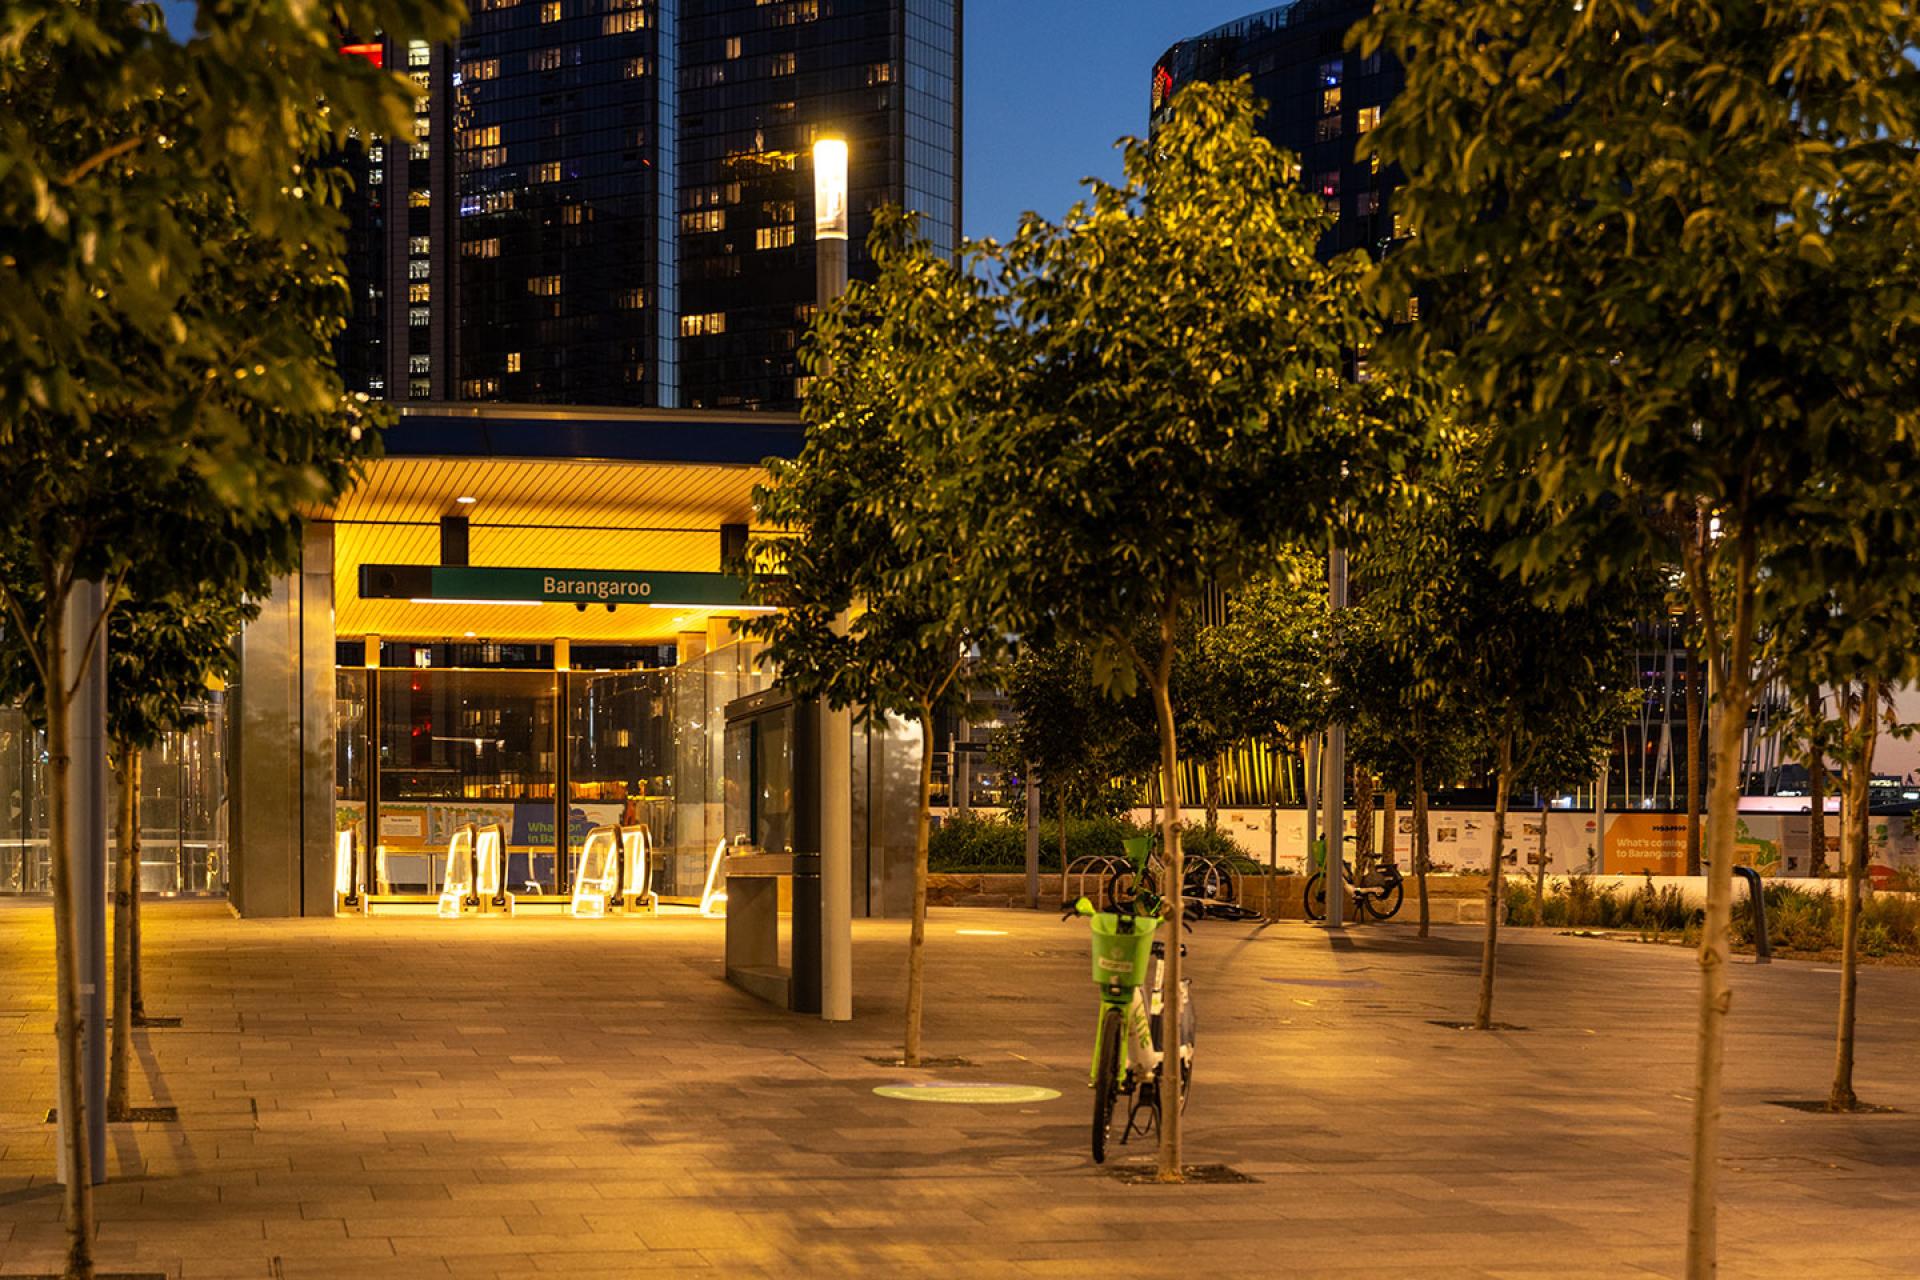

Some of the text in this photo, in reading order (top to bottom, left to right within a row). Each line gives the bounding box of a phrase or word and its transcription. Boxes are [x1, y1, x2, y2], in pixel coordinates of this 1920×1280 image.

[543, 576, 652, 599] Barangaroo
[527, 822, 556, 833] Wha
[1616, 838, 1687, 849] What's coming
[1616, 849, 1684, 860] to Barangaroo
